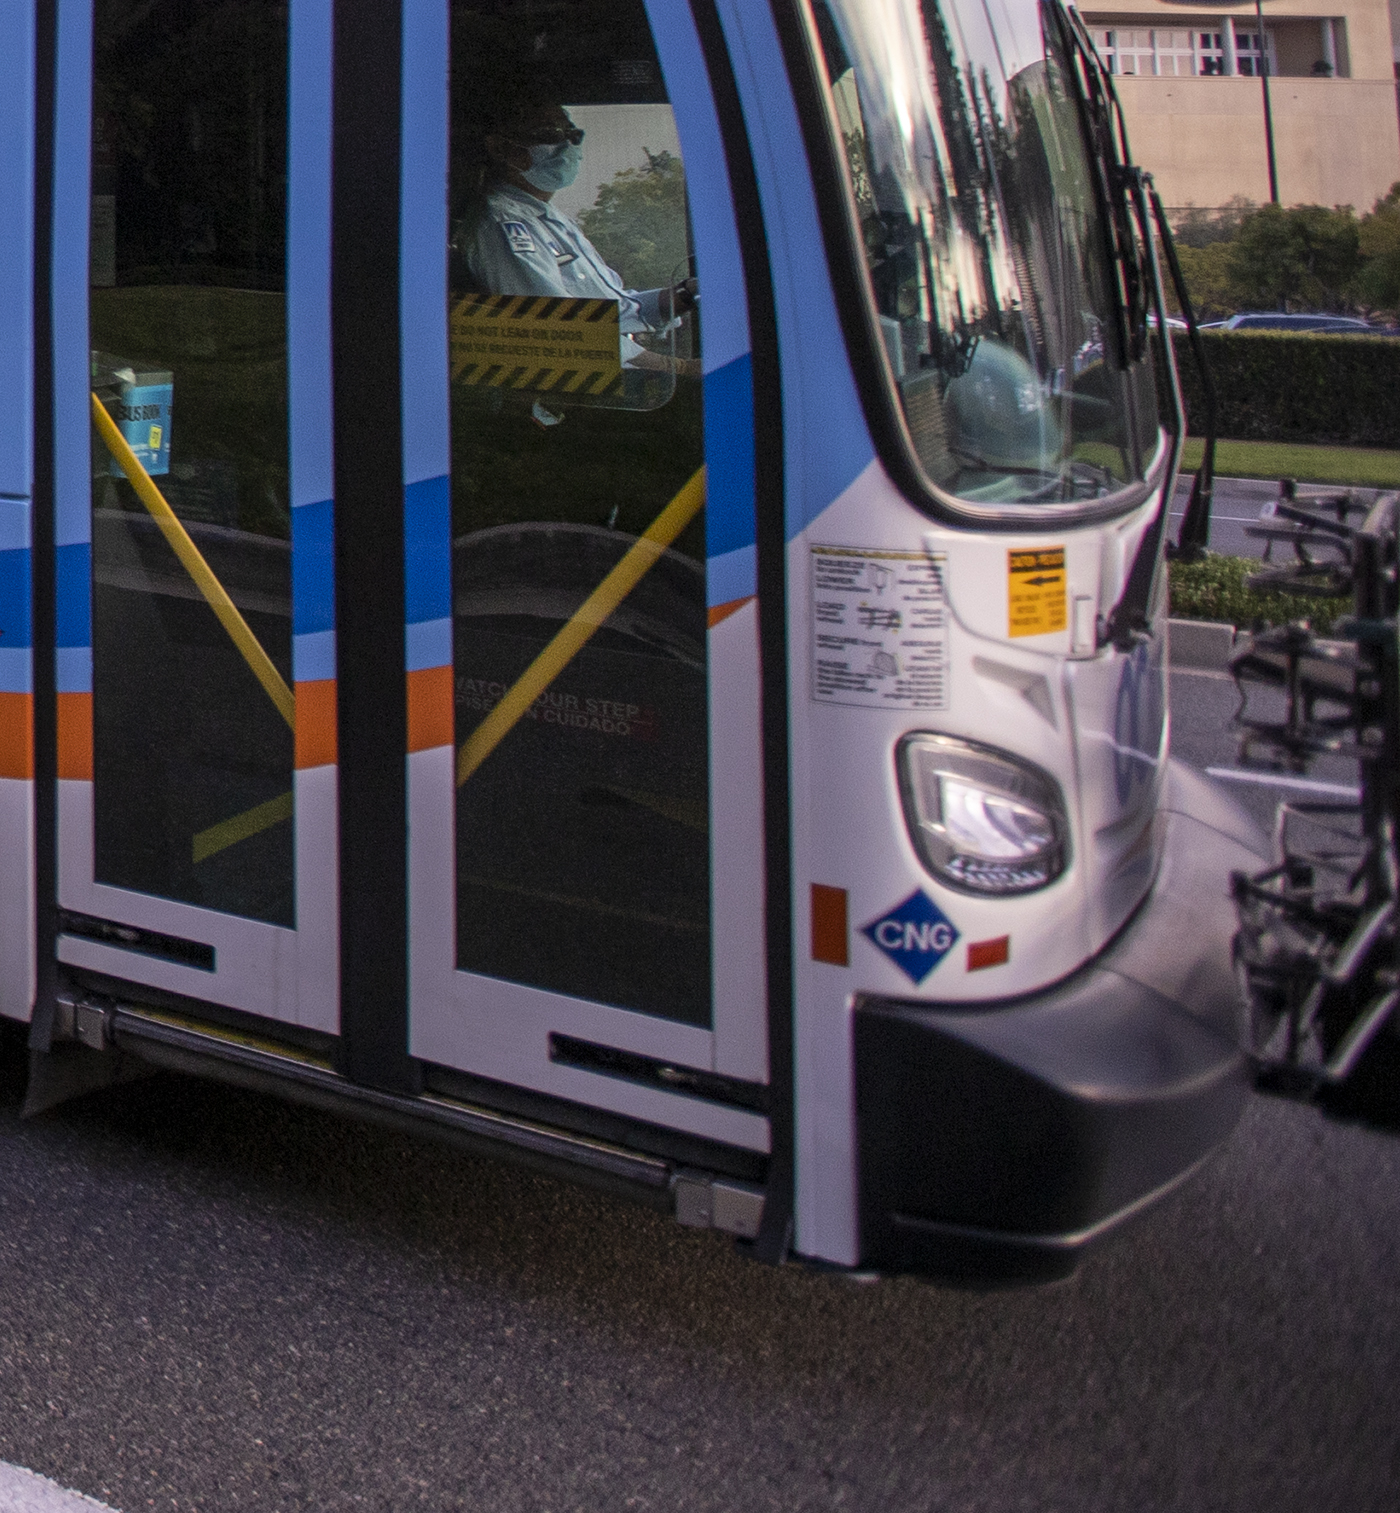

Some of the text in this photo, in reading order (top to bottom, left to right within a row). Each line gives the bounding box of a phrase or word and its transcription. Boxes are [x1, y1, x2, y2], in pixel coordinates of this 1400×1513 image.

[536, 692, 579, 710] OUR
[585, 698, 640, 719] STEP
[543, 709, 631, 736] CUIDADO
[874, 920, 952, 952] CNG
